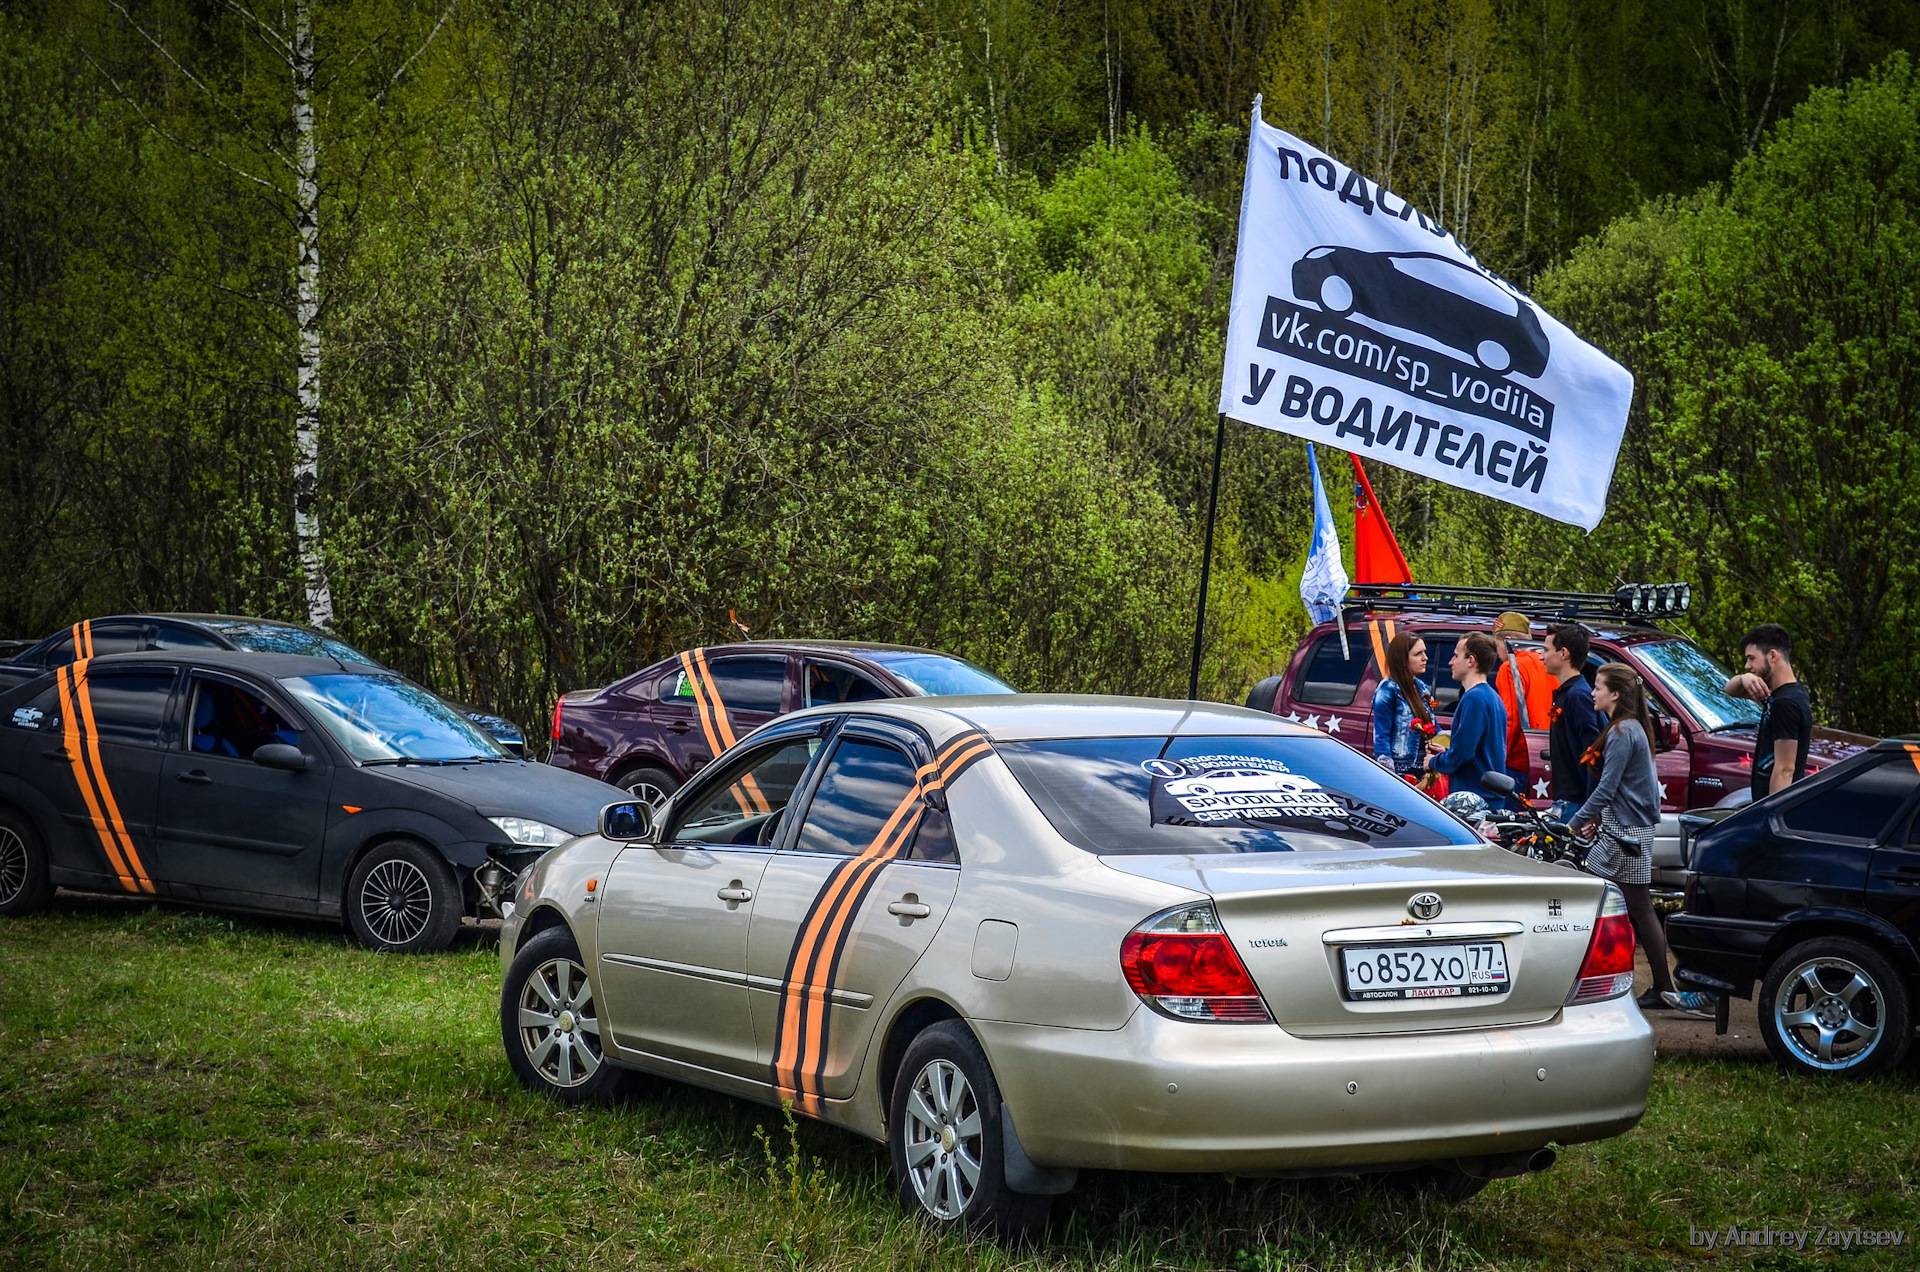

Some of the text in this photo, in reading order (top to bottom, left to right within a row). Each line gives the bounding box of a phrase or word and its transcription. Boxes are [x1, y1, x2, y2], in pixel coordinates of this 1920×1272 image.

[1270, 310, 1545, 428] vk.com/sp_vodila
[1241, 363, 1549, 494] У ВОДИТЕЛЕЙ
[1179, 755, 1284, 766] ПОДСЛУШАНО
[1186, 761, 1290, 773] У ВОДИТЕЛЕЙ
[1151, 761, 1176, 776] 1
[1186, 794, 1332, 808] SPVODILA.RU
[1194, 807, 1281, 822] СЕРГИЕВ
[1281, 807, 1350, 817] ПОСАД
[1533, 923, 1571, 933] CAMRY
[1249, 938, 1288, 948] TOYOTA
[1469, 946, 1494, 970] 77
[1471, 971, 1491, 980] RUS
[1362, 986, 1498, 999] АВТОСАЛОН ЛАКИ КАР 921-10-10
